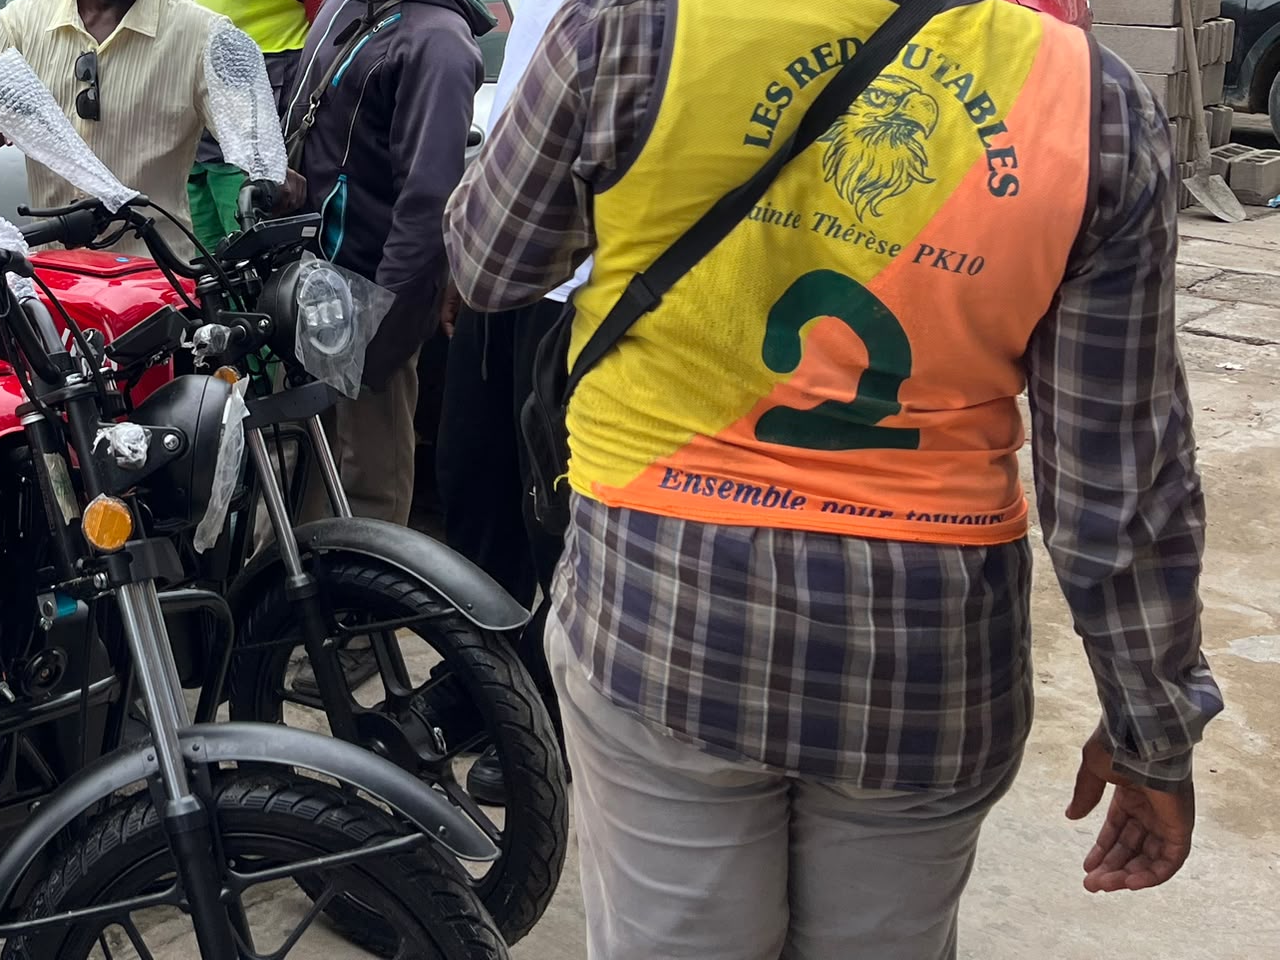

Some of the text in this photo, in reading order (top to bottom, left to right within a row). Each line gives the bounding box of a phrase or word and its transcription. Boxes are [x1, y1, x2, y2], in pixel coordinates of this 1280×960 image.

[743, 36, 1020, 198] LES REDUTABLES
[747, 202, 986, 277] ainte Thérèse PK10
[754, 269, 920, 451] 2
[658, 466, 807, 511] Ensemble
